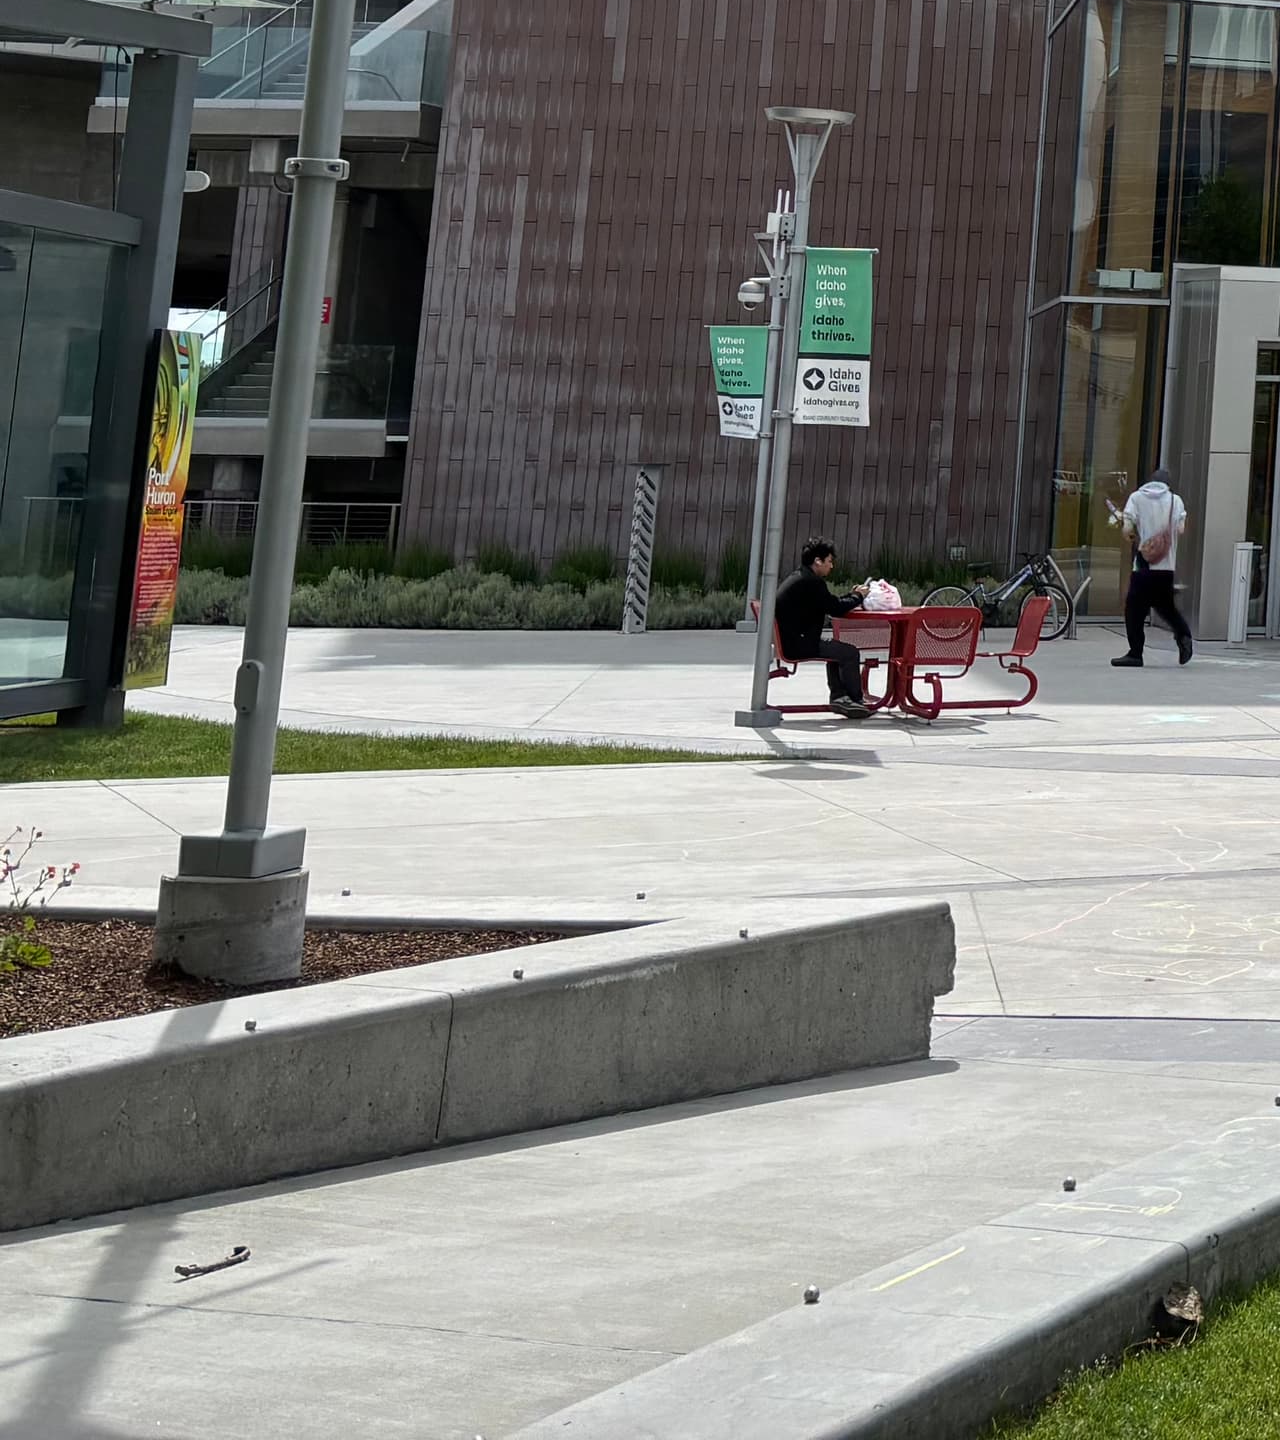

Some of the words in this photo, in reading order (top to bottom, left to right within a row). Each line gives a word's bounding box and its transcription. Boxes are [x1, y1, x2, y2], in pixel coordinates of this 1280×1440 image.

[817, 264, 847, 276] When
[815, 280, 846, 291] Idaho
[815, 294, 846, 309] gives,
[812, 315, 845, 326] Idaho
[718, 336, 745, 345] When
[811, 330, 855, 342] thrives.
[829, 368, 862, 380] Idaho
[721, 378, 751, 387] hrives.
[828, 381, 860, 393] Gives
[803, 397, 860, 410] idahogives.org
[148, 467, 170, 486] Port
[146, 486, 176, 505] Huron
